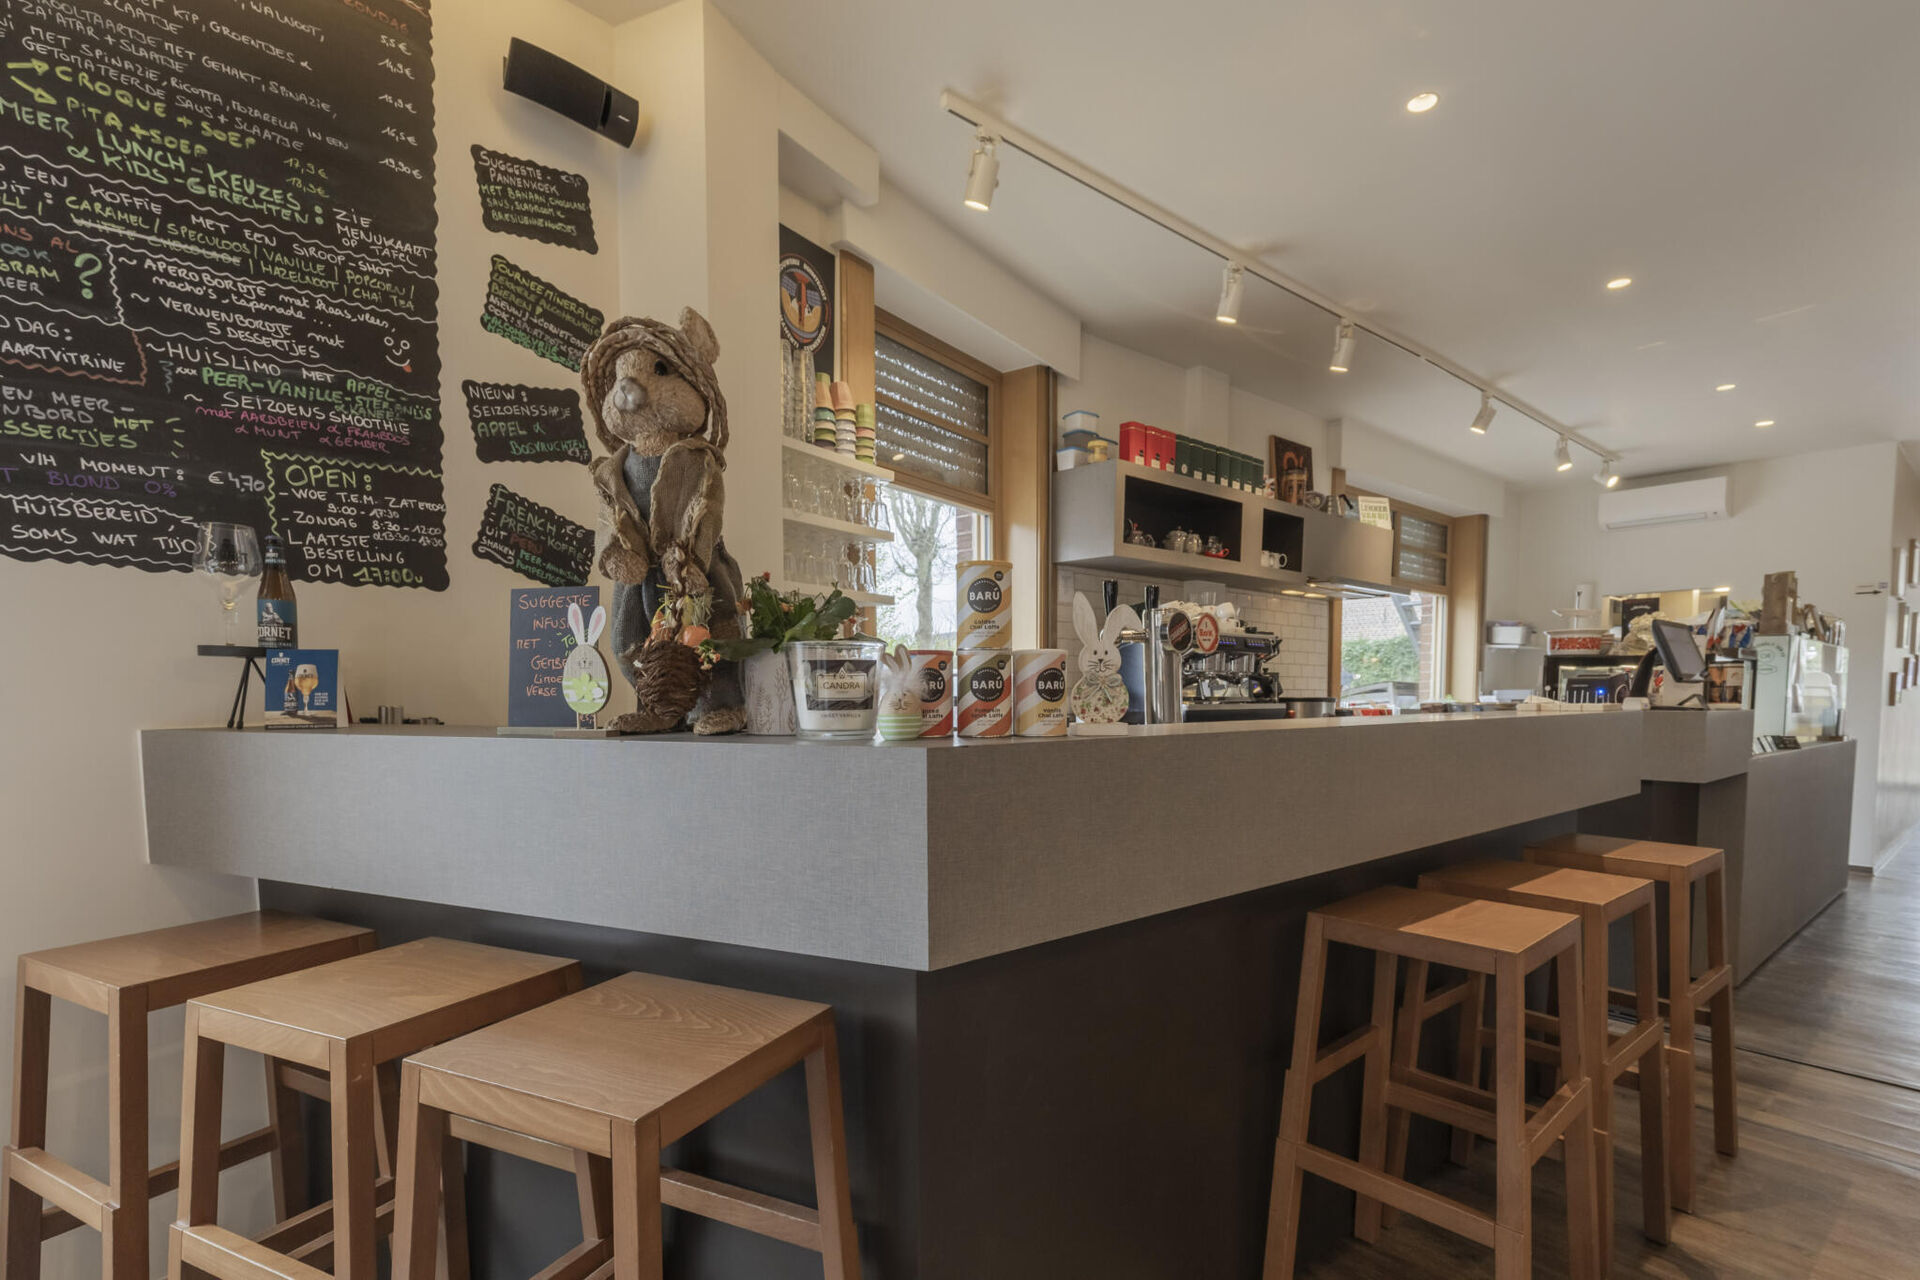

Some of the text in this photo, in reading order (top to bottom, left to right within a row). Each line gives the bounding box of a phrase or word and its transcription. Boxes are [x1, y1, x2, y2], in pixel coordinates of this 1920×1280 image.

[31, 26, 71, 48] MET
[210, 21, 295, 63] GROENTJES
[165, 42, 196, 60] MET
[55, 66, 167, 118] CROQUE
[200, 121, 256, 149] SOEP
[175, 95, 214, 118] SAUS
[478, 151, 542, 180] SUGGESTIE
[481, 184, 502, 195] MET
[489, 168, 560, 196] PANNENKOEK
[24, 165, 68, 188] EEN
[191, 214, 230, 234] MET
[243, 229, 277, 247] EEN
[65, 196, 150, 229] CARAMEL
[166, 223, 250, 254] SPECULOOS
[262, 248, 326, 274] VANILLE
[336, 223, 433, 259] MENUKAART
[51, 237, 79, 253] AL
[342, 237, 418, 267] OP TAFEL
[260, 260, 340, 291] HAZELNOOT
[207, 322, 221, 335] 5
[302, 368, 335, 383] MET
[113, 417, 153, 431] MET
[477, 421, 528, 437] APPEL
[254, 425, 302, 440] MUNT
[334, 436, 390, 454] GEMBER
[48, 470, 120, 490] BLOND
[291, 488, 327, 500] WOE
[293, 511, 357, 528] ZONDAG
[495, 488, 556, 536] FRENCH
[11, 524, 138, 547] SOMS WAT
[288, 530, 370, 549] LAATSTE
[303, 547, 404, 564] BESTELLING
[308, 564, 343, 578] OM
[969, 587, 1000, 601] BARÚ
[526, 686, 557, 697] VERSE
[822, 681, 861, 690] CANDRA
[972, 676, 1003, 690] BARÚ
[1038, 677, 1064, 690] BARÚ
